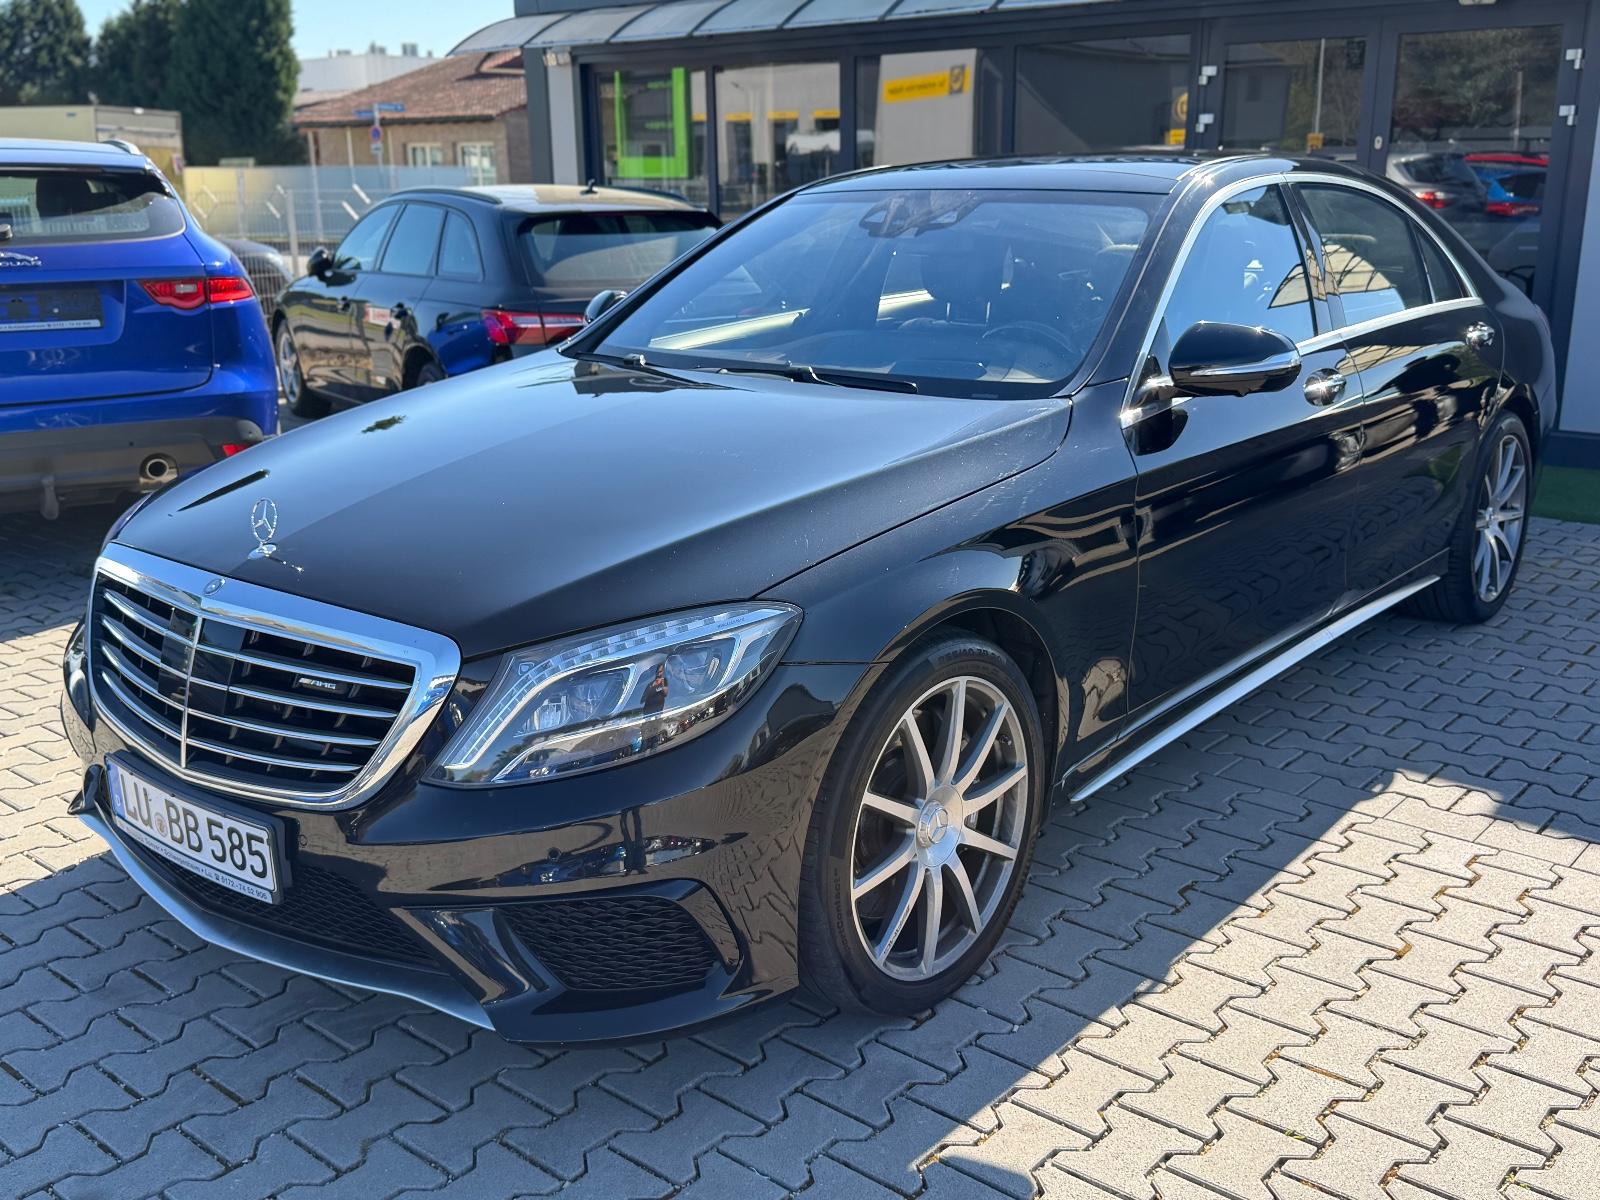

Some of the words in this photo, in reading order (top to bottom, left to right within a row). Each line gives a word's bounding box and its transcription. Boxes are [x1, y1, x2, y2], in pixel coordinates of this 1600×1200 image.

[311, 679, 336, 690] AMG
[120, 773, 153, 830] LU
[165, 798, 204, 853] BB
[206, 817, 268, 879] 585
